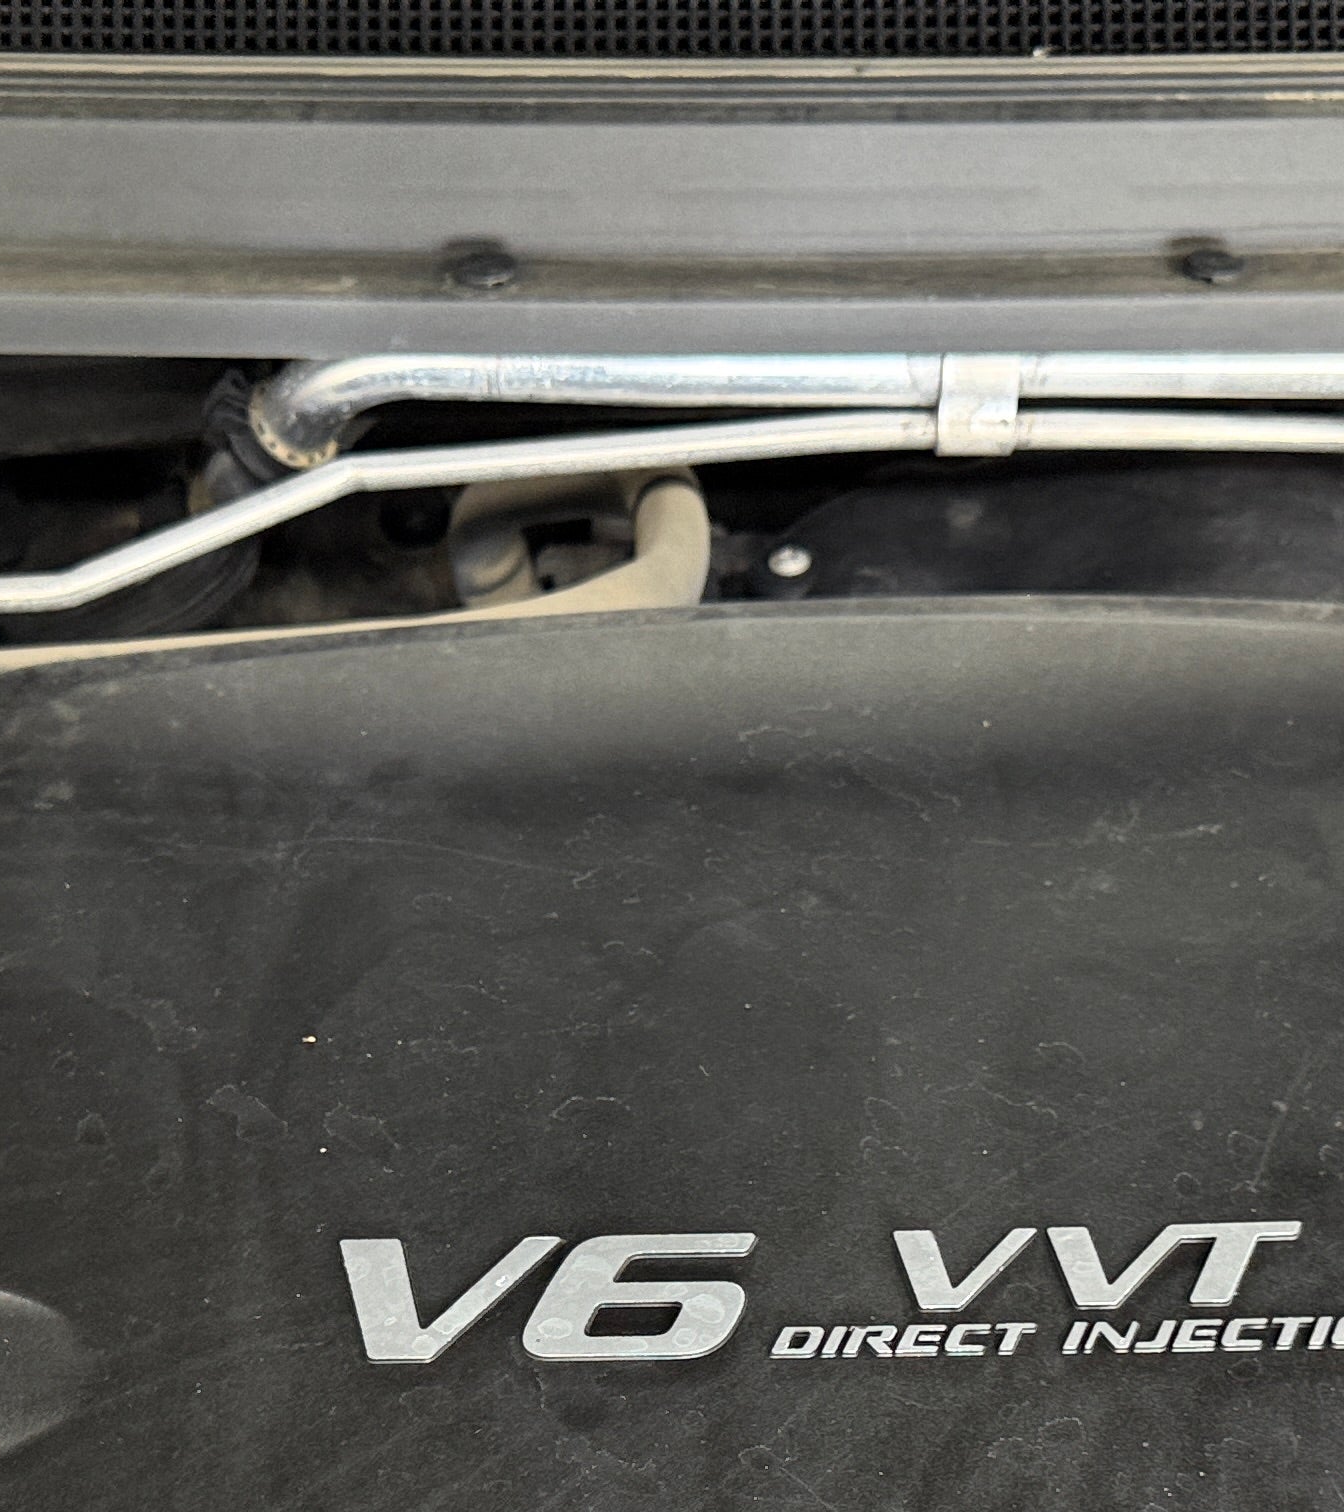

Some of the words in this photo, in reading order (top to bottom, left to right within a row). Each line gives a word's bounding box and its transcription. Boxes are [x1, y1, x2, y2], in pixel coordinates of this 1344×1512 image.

[339, 1233, 757, 1363] V6
[893, 1221, 1302, 1314] VVT
[769, 1322, 1037, 1359] DIRECT
